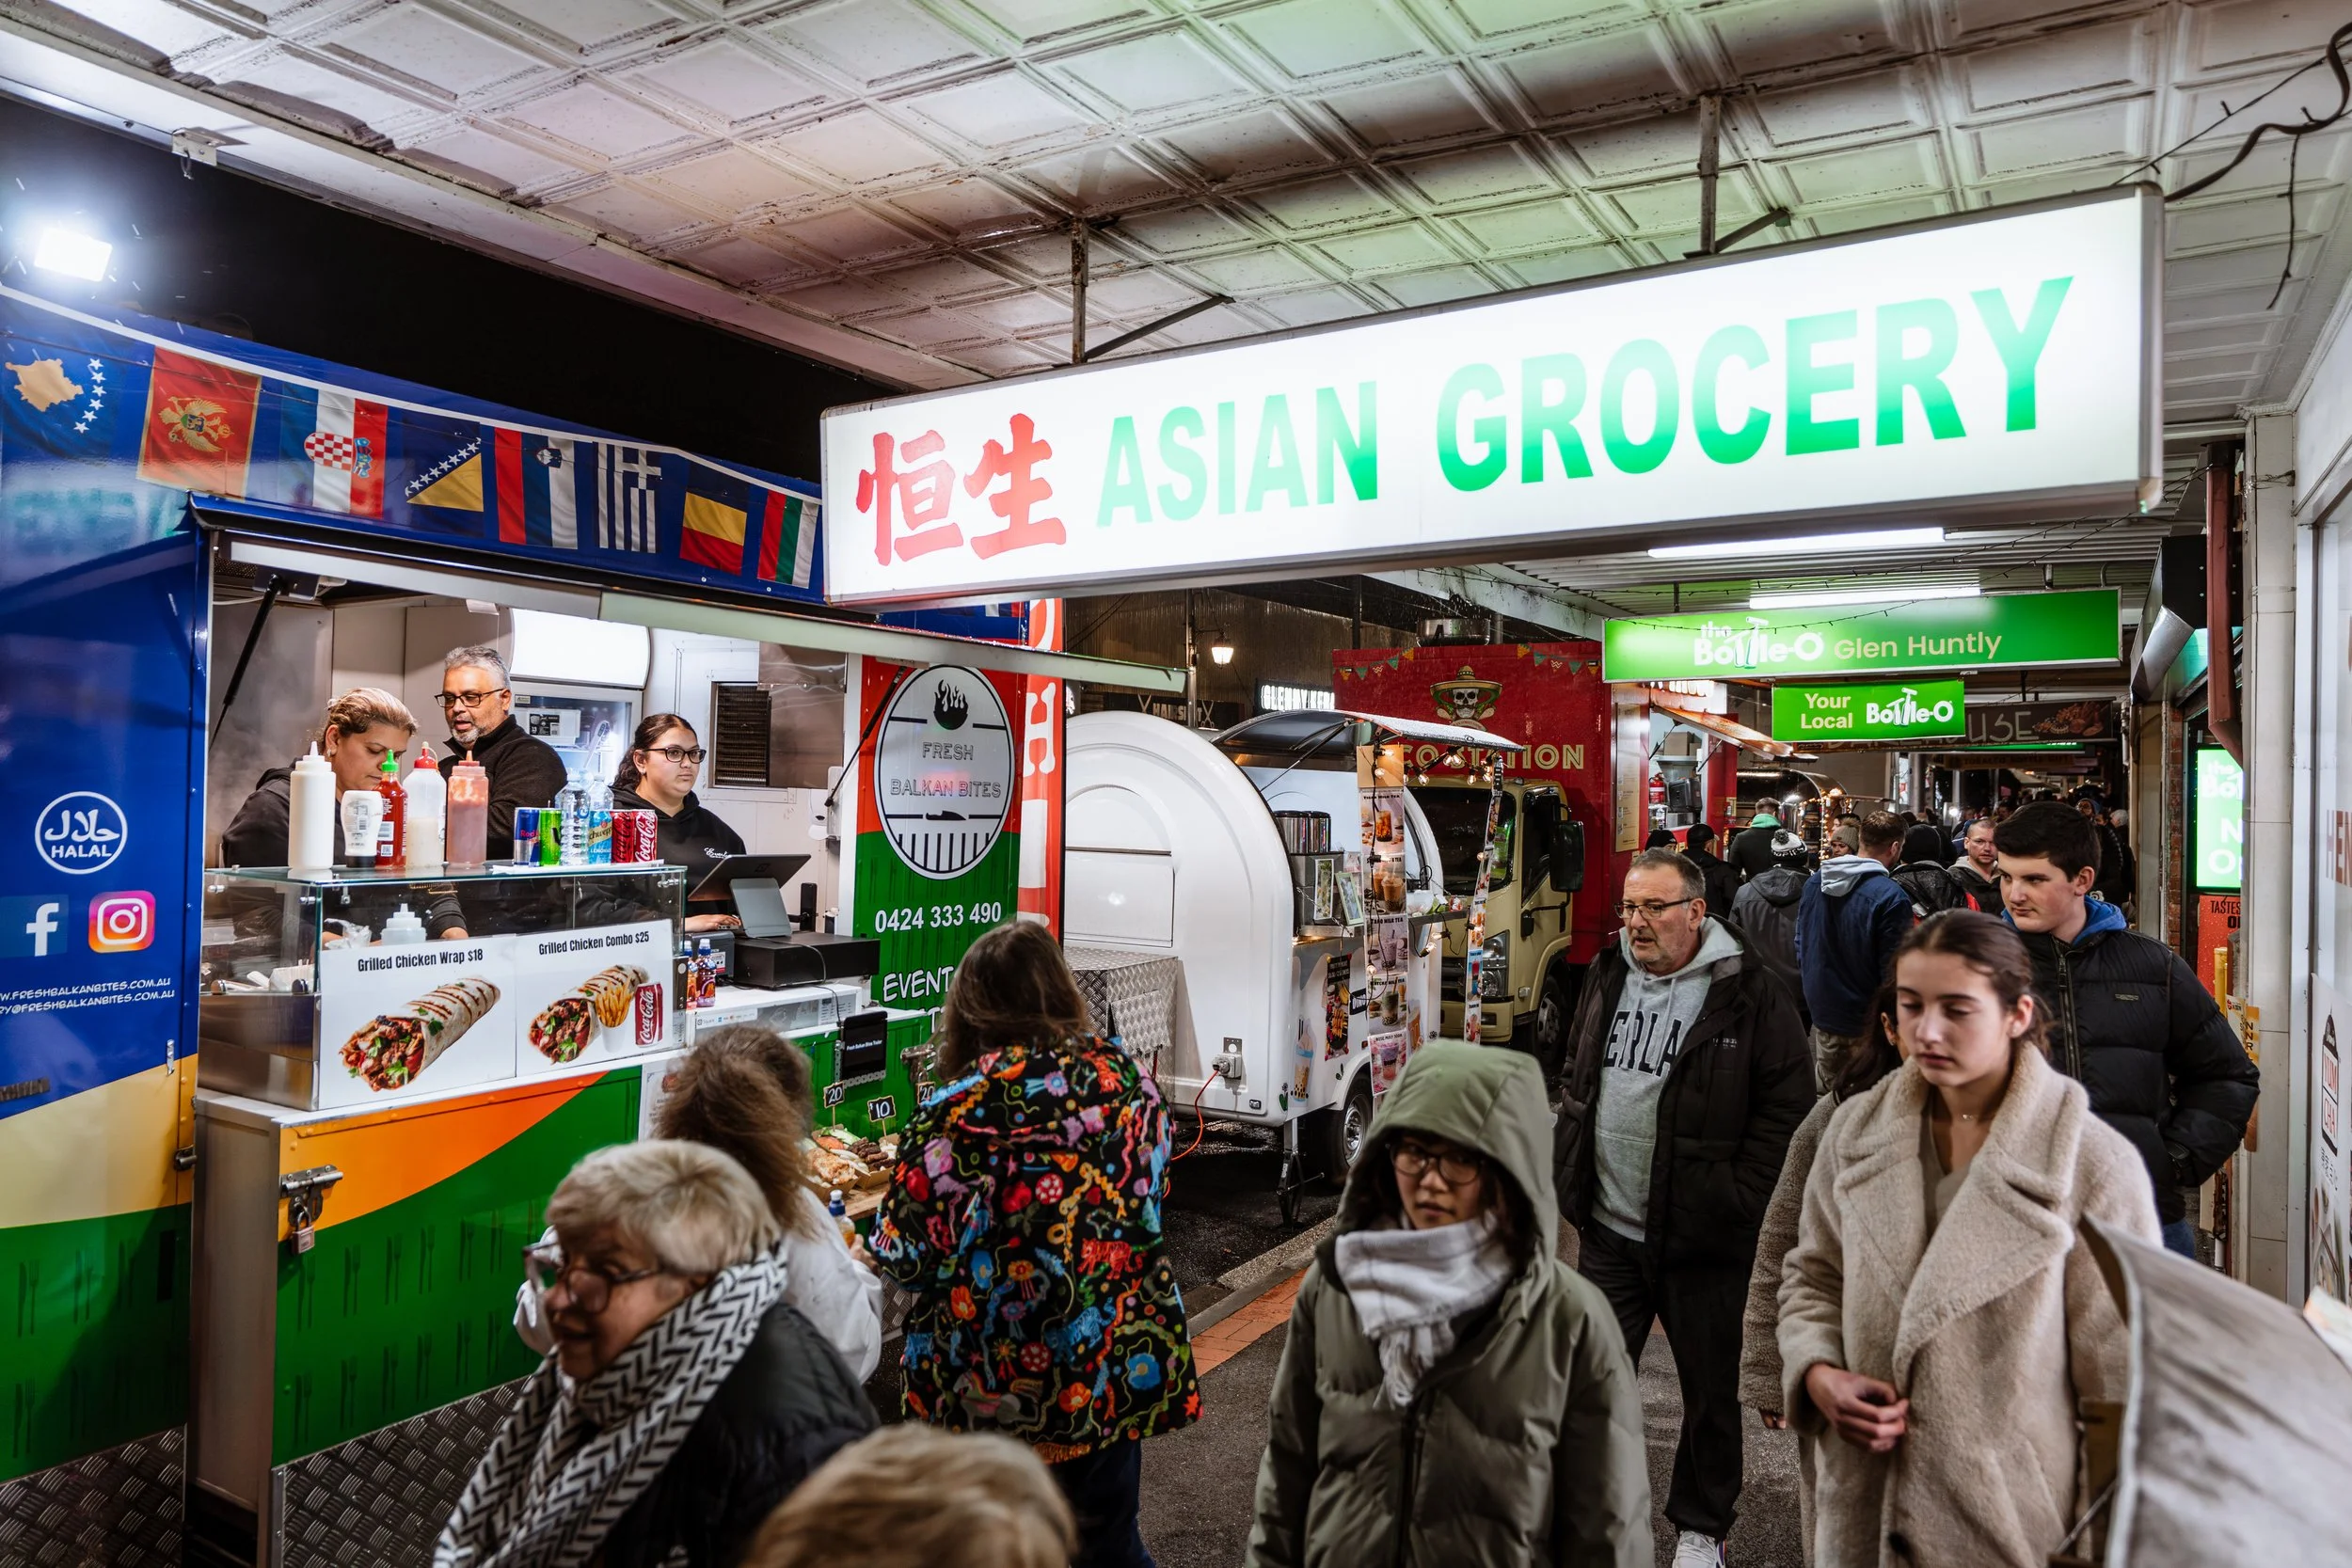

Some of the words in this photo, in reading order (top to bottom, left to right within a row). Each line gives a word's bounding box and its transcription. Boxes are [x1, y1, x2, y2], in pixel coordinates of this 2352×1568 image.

[1095, 379, 1379, 529] ASIAN
[1436, 275, 2075, 494] GROCERY
[856, 412, 1067, 567] 恒生
[1701, 621, 1732, 639] the
[1835, 639, 1899, 659] Glen
[1908, 631, 2003, 659] Huntly
[1804, 693, 1851, 709] Your
[1801, 712, 1853, 729] Local
[922, 742, 975, 761] FRESH
[890, 779, 954, 797] BALKAN
[959, 780, 1002, 799] BITES
[44, 809, 120, 843] حلال
[51, 845, 112, 859] HALAL
[875, 906, 925, 933] 0424
[930, 904, 964, 927] 333
[969, 901, 1002, 925] 490
[538, 942, 567, 956] Grilled
[569, 937, 604, 952] Chicken
[605, 934, 633, 947] Combo
[635, 930, 649, 943] $25
[358, 954, 393, 973] Grilled
[395, 952, 437, 970] Chicken
[439, 950, 465, 966] Wrap
[468, 948, 484, 963] $18
[0, 977, 171, 1002] W.FRESHBALKANBITES.COM.AU
